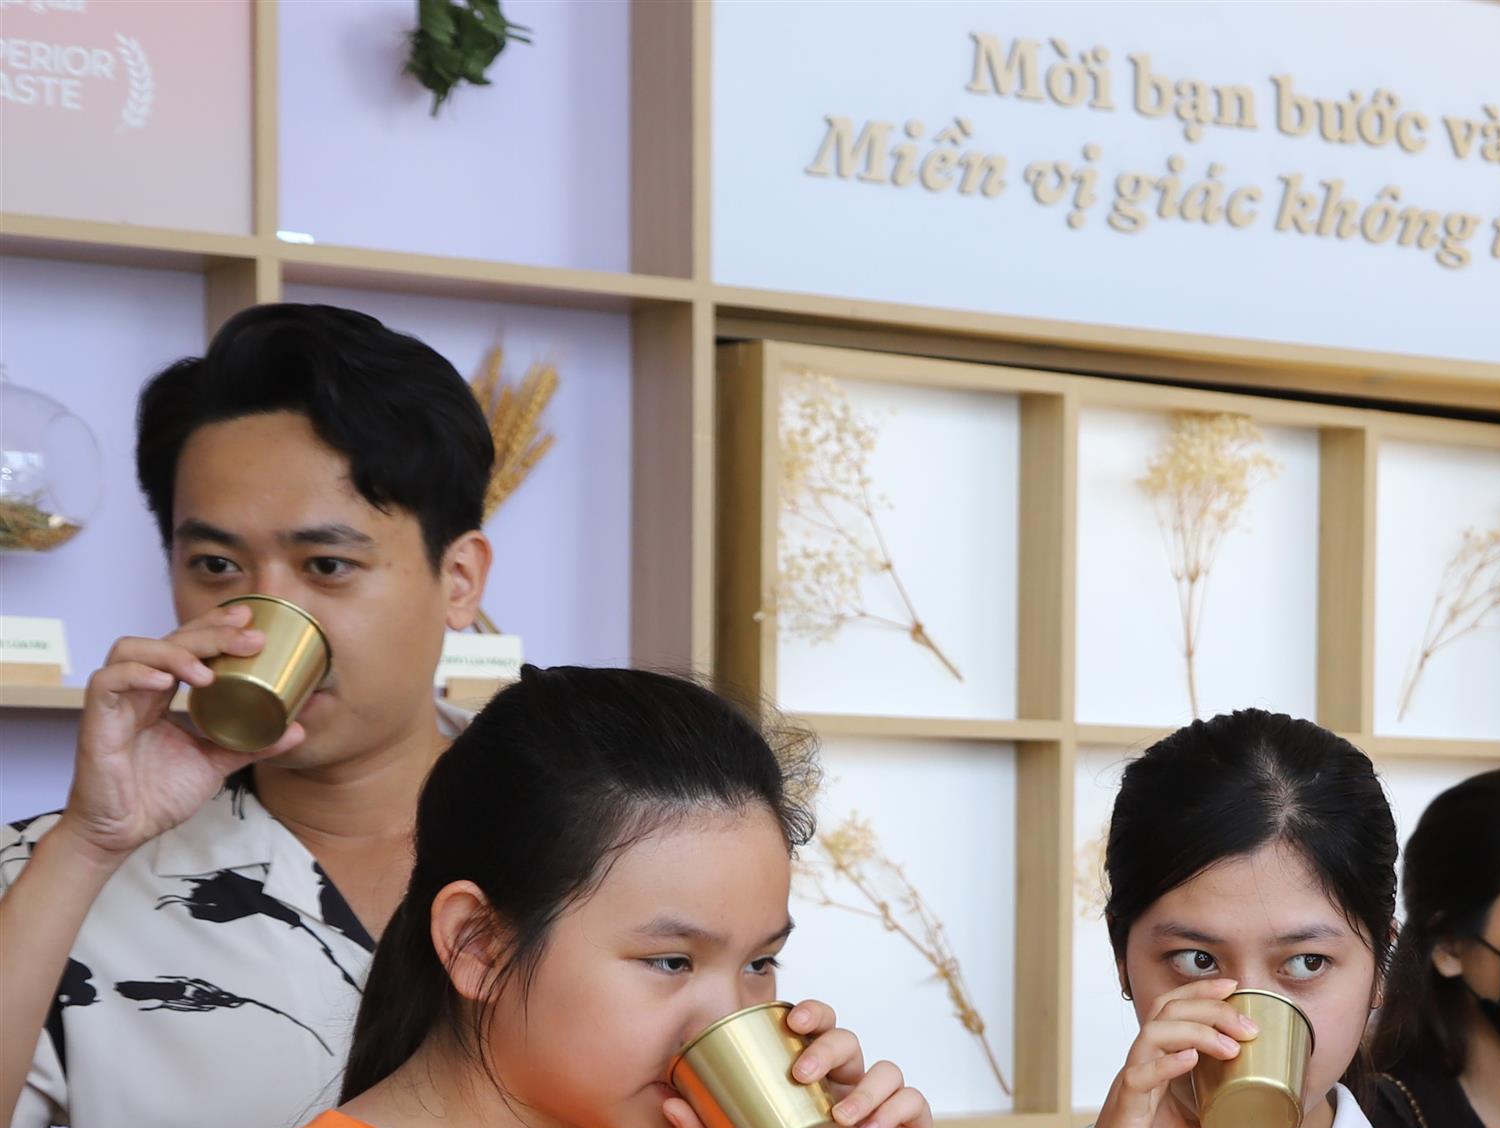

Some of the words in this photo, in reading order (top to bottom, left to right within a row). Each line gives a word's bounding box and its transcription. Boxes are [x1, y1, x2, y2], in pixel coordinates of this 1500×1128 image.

[0, 37, 115, 80] ERIOR
[966, 30, 1116, 112] Mời
[1128, 52, 1258, 143] bạn
[1270, 73, 1429, 153] bước
[805, 114, 1008, 199] Miền
[1024, 143, 1101, 229] vị
[1107, 154, 1263, 234] giác
[1274, 172, 1481, 270] không
